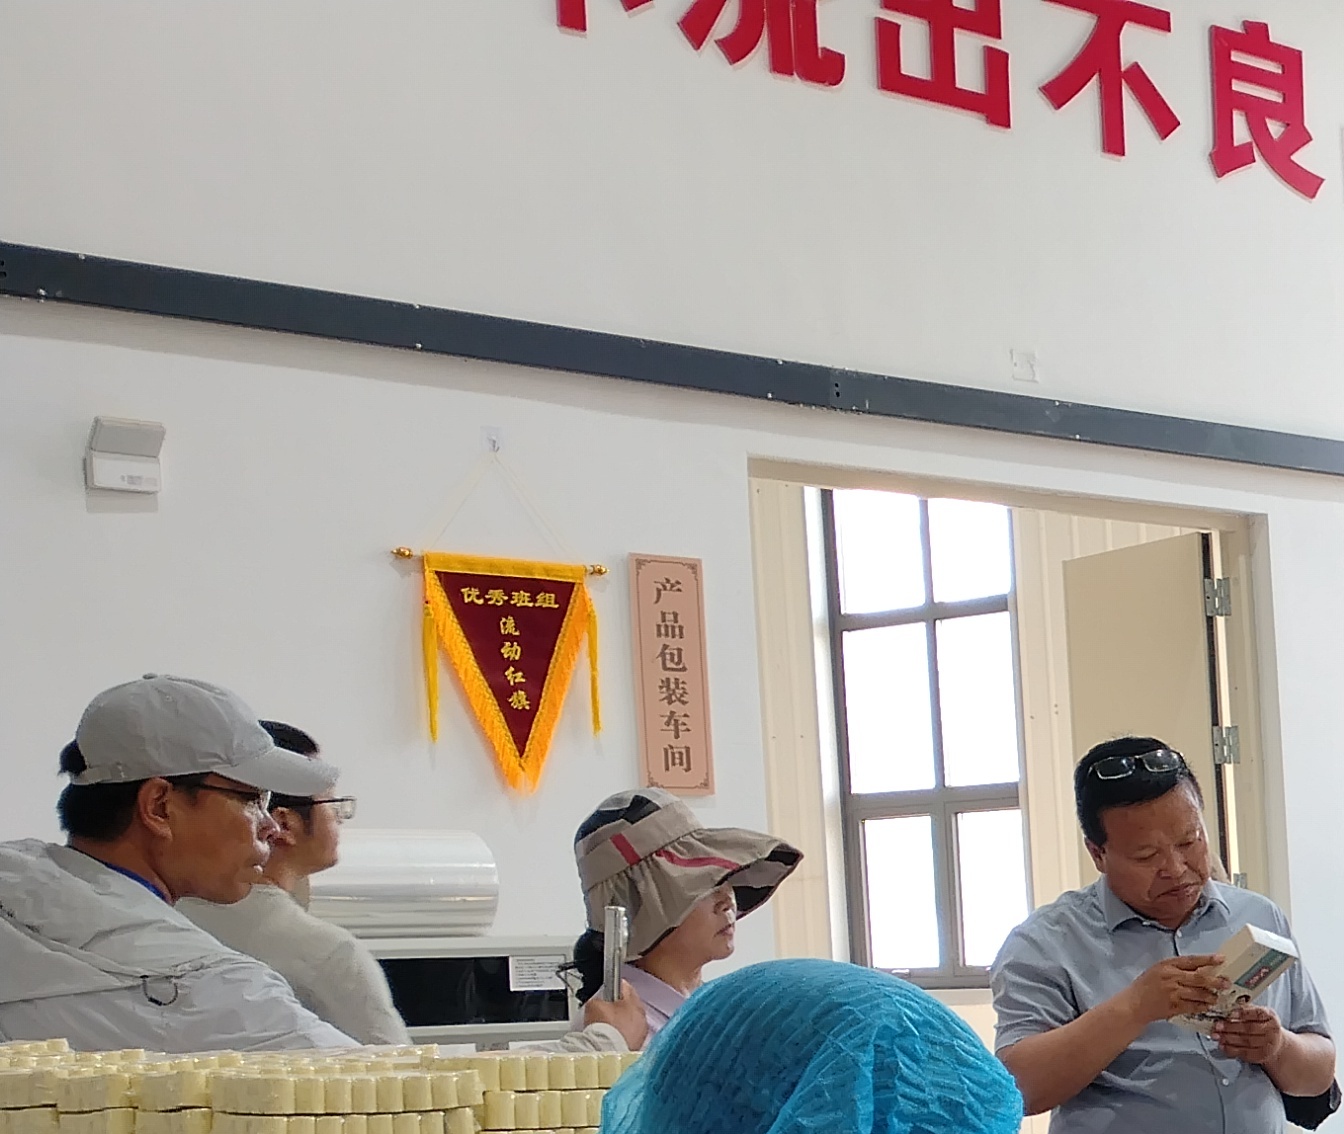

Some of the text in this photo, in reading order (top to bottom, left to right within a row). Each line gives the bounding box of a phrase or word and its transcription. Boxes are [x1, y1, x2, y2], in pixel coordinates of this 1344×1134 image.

[460, 586, 560, 609] 优秀班组
[499, 615, 531, 711] 流动红旗
[653, 576, 693, 773] 产品包装车间
